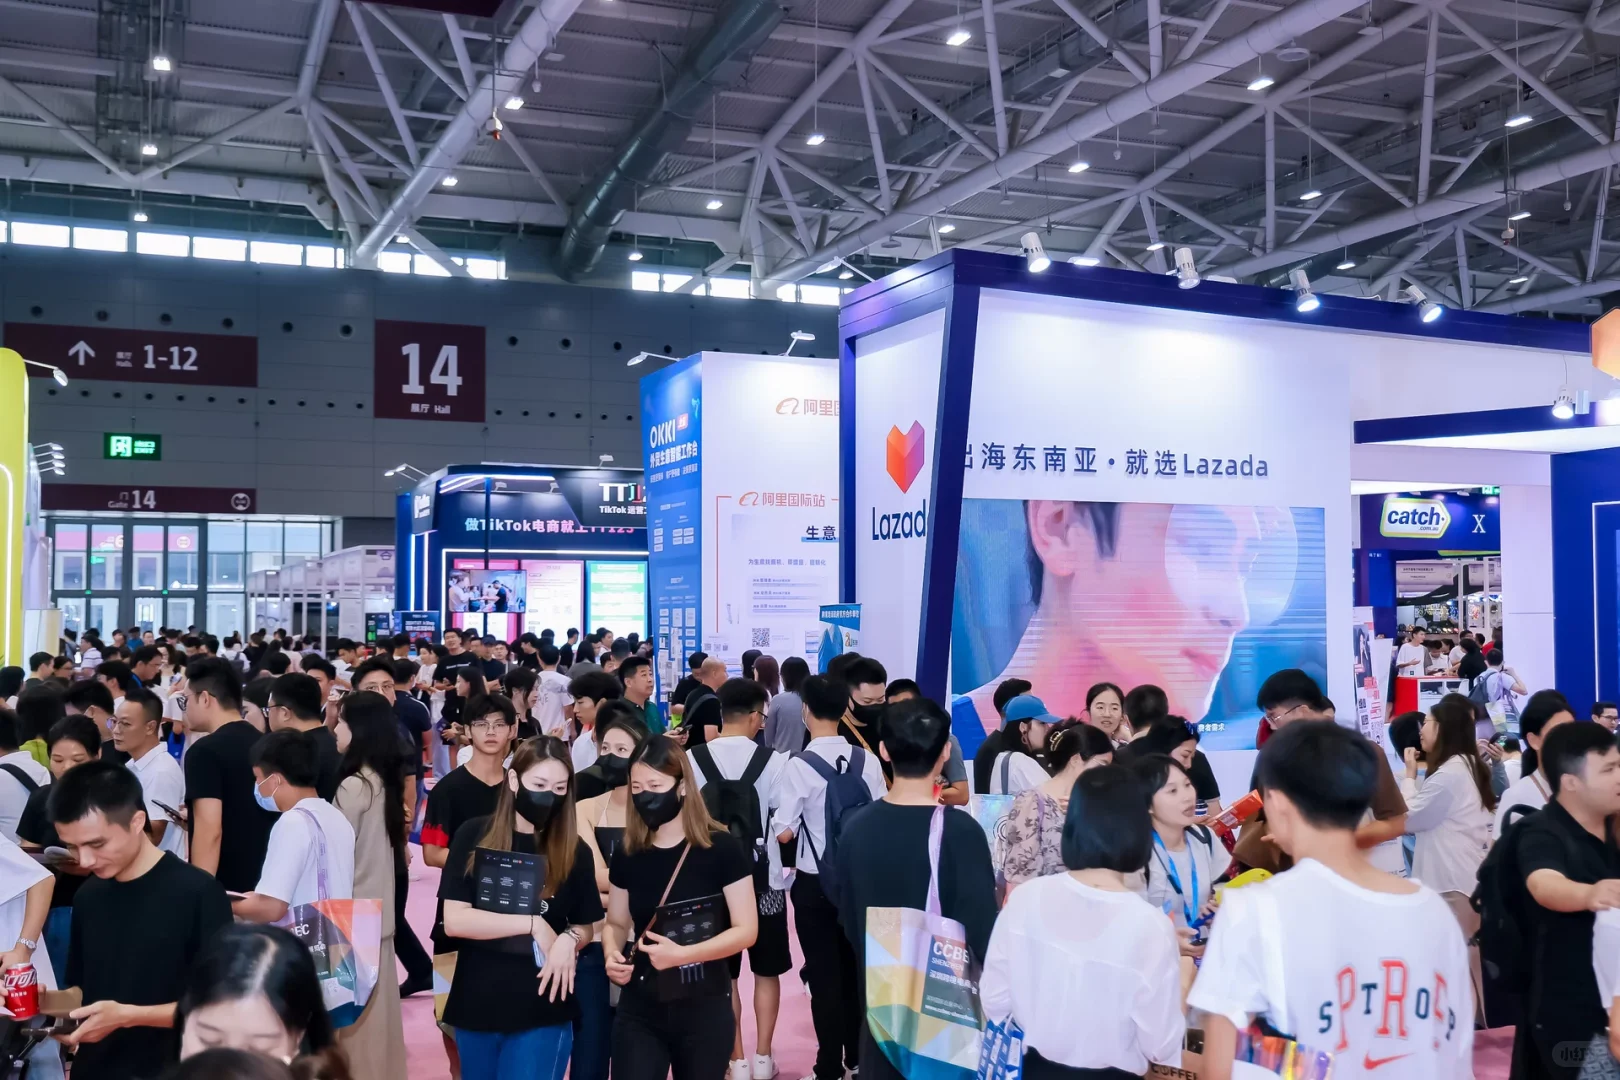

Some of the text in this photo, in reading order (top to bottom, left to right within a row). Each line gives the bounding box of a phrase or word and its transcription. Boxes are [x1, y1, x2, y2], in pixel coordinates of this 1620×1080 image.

[143, 344, 198, 371] 1-12
[401, 343, 463, 396] 14
[410, 403, 450, 414] 展厅 Hall
[650, 418, 676, 449] OKKI
[132, 490, 156, 509] 14
[762, 492, 826, 508] 阿里国际站
[598, 505, 627, 514] TikTok
[1387, 507, 1440, 526] catch
[805, 525, 837, 541] 生意
[1471, 514, 1487, 534] X
[931, 956, 965, 972] SHENZHEN
